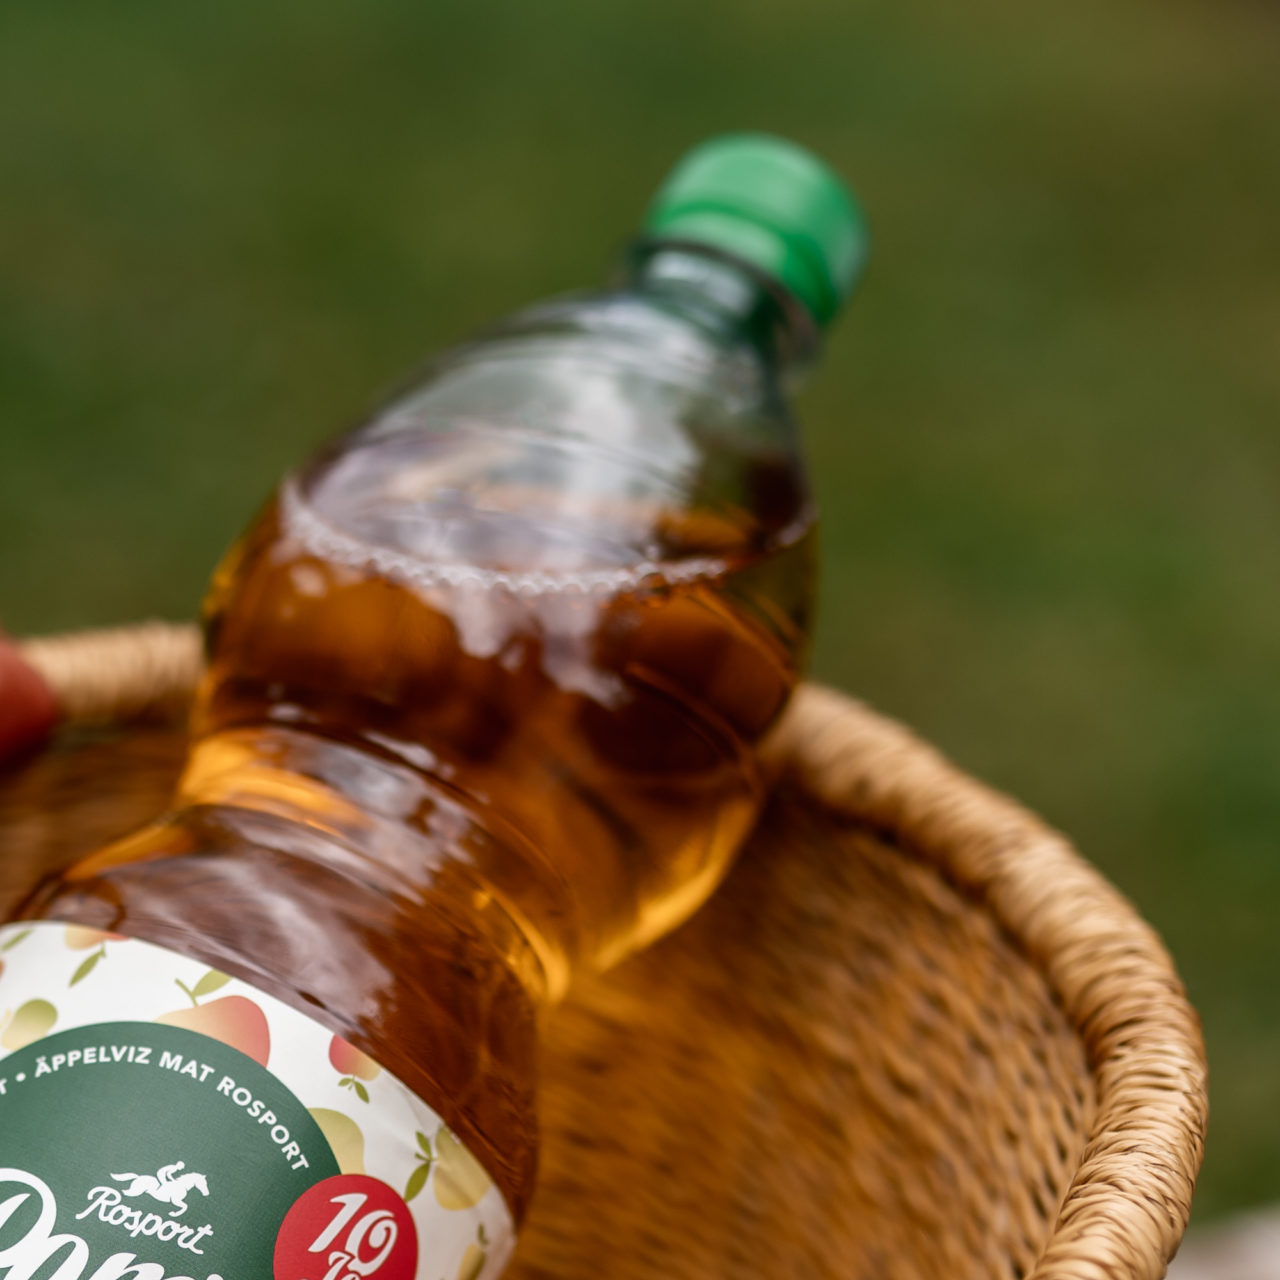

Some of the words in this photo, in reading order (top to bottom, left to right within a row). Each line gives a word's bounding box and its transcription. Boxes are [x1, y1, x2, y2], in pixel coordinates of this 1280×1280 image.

[34, 1045, 152, 1078] ÄPPELVIZ
[158, 1051, 216, 1083] MAT
[217, 1075, 310, 1171] ROSPORT
[75, 1186, 214, 1256] Rosport
[308, 1192, 398, 1277] 10
